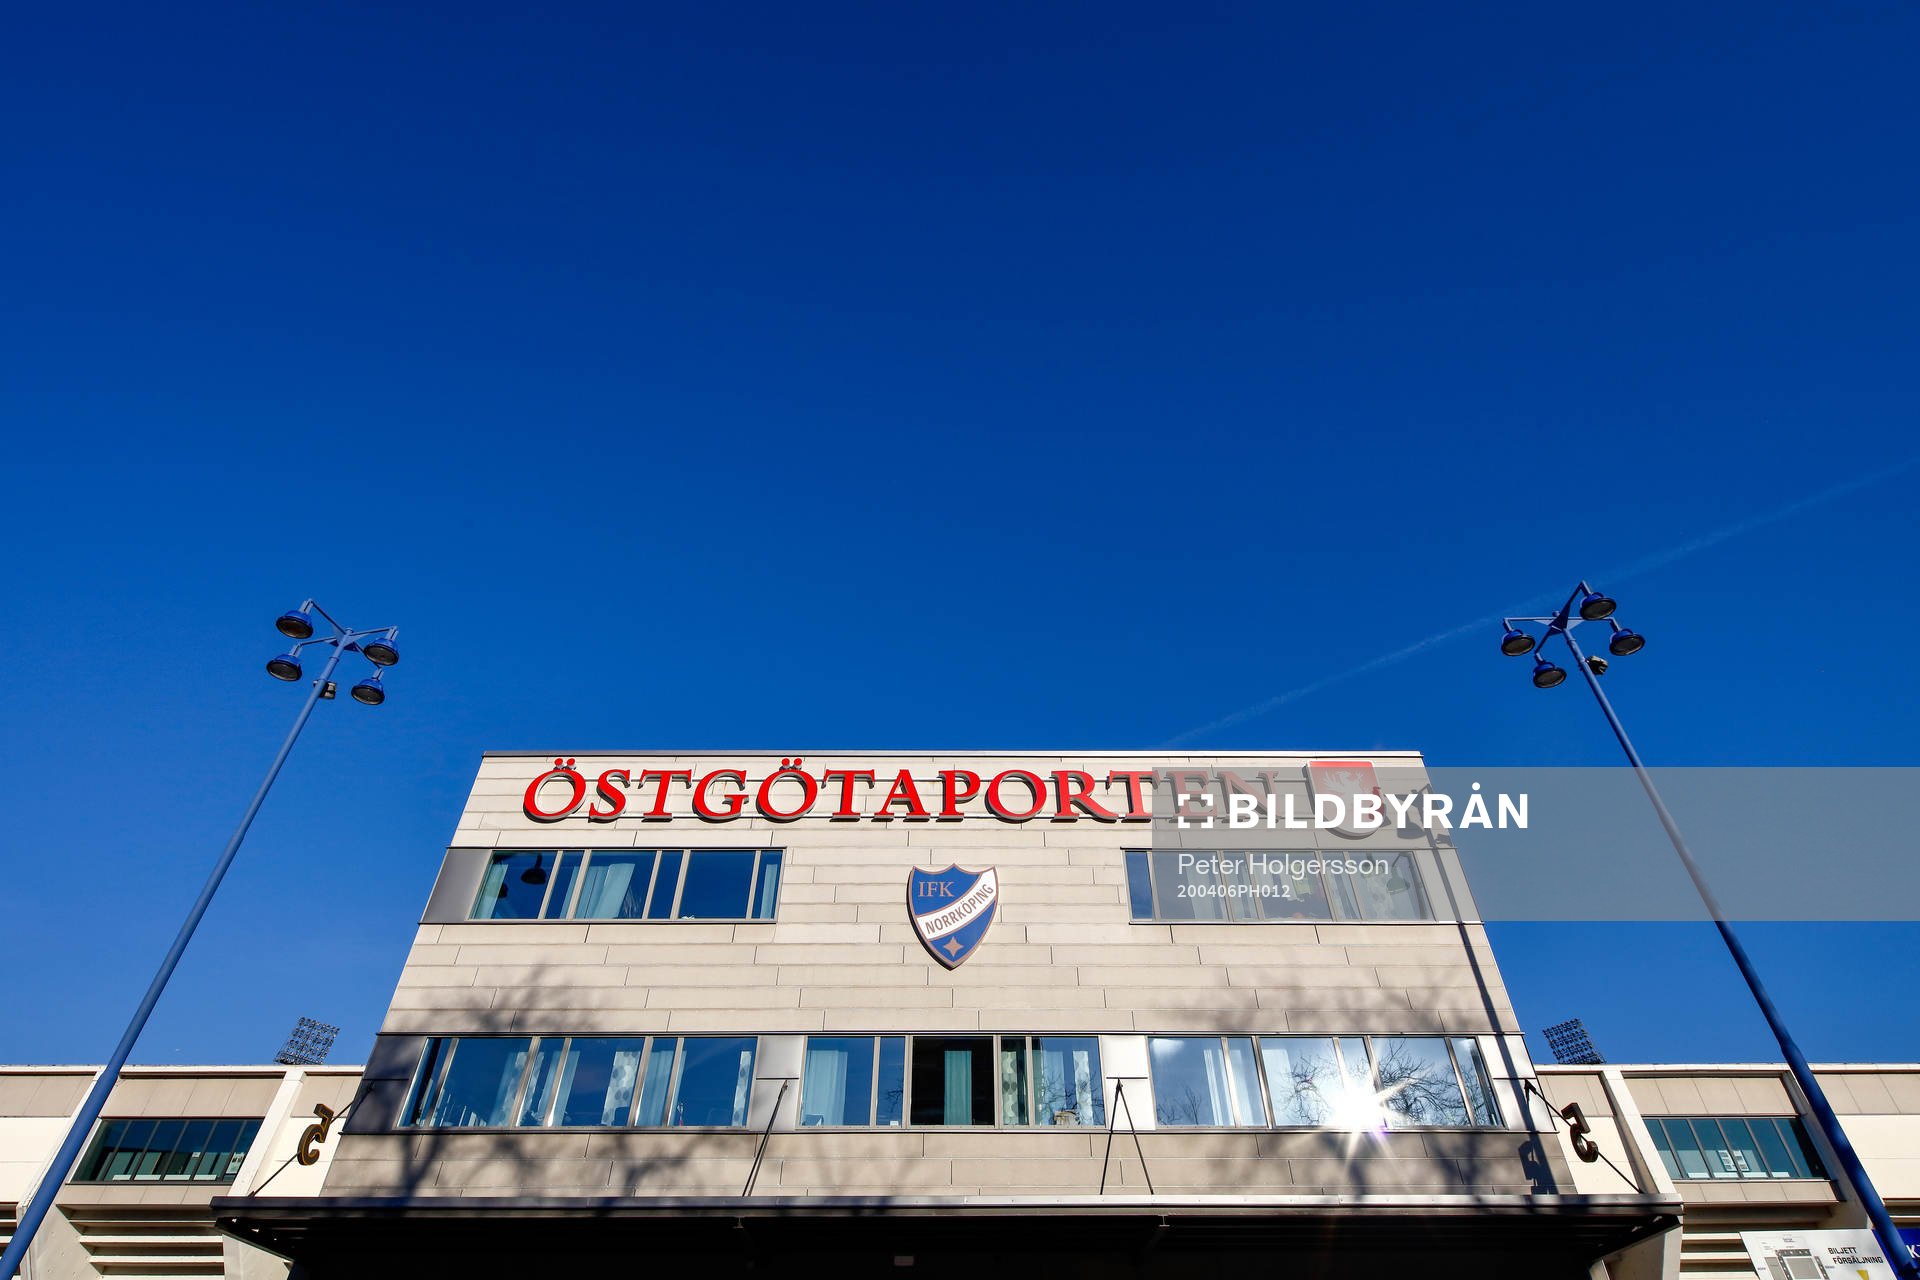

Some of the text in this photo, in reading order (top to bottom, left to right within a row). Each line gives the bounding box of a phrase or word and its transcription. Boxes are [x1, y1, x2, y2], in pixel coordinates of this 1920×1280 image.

[523, 758, 1280, 822] ÖSTGÖTAPORTEN
[918, 881, 955, 898] IFK
[925, 883, 995, 935] NORRKÖPING
[1828, 1247, 1857, 1255] BILJETT
[1832, 1255, 1884, 1265] FÖRSÄLJNING
